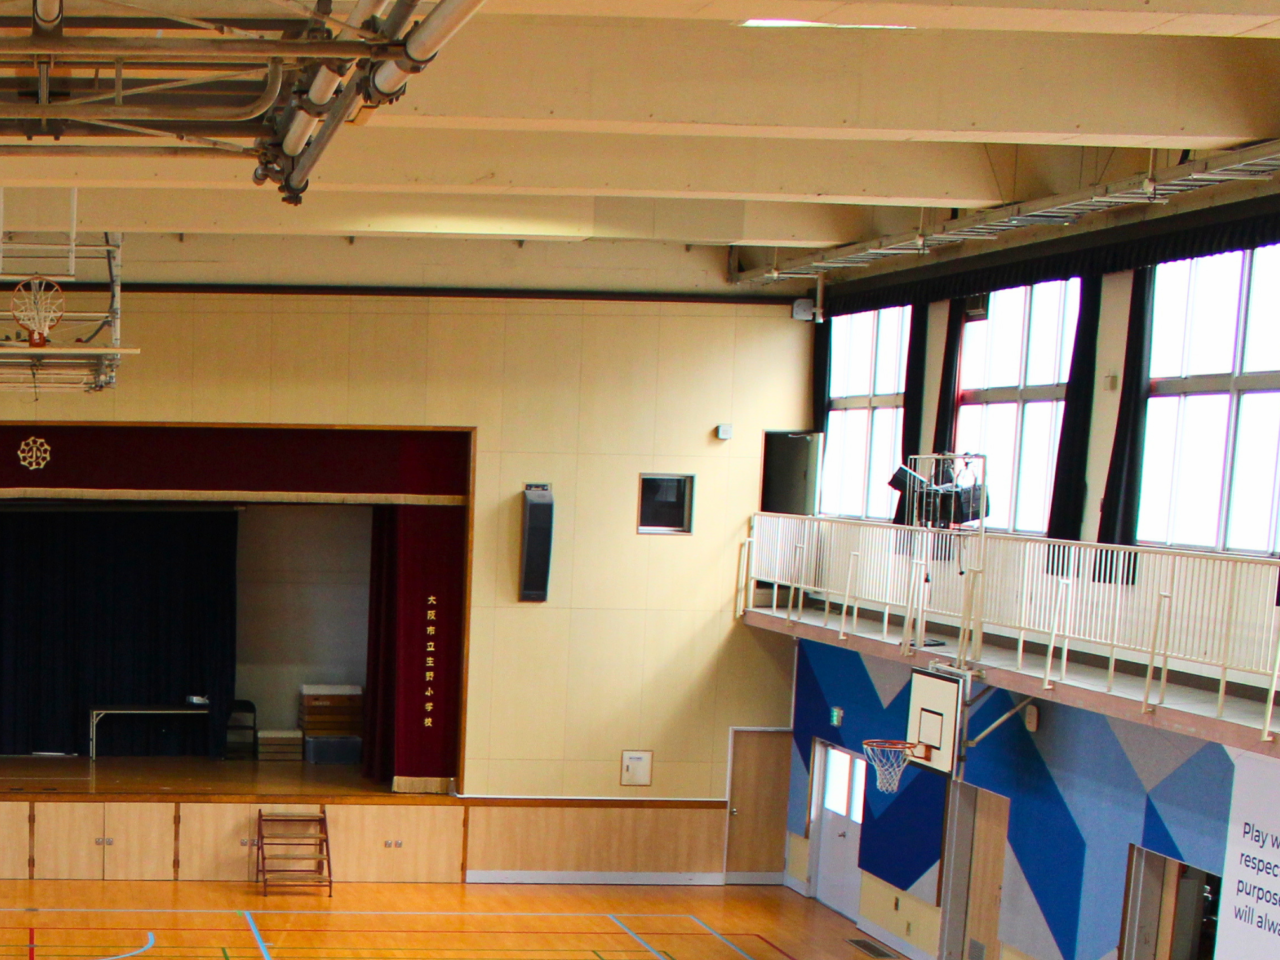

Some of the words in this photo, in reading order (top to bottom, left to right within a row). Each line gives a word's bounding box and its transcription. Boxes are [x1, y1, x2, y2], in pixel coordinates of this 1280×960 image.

[424, 595, 437, 727] 大阪市立生野小学校
[1242, 822, 1269, 849] Play
[1239, 852, 1280, 878] respec
[1236, 879, 1280, 907] purpos
[1234, 904, 1255, 926] will
